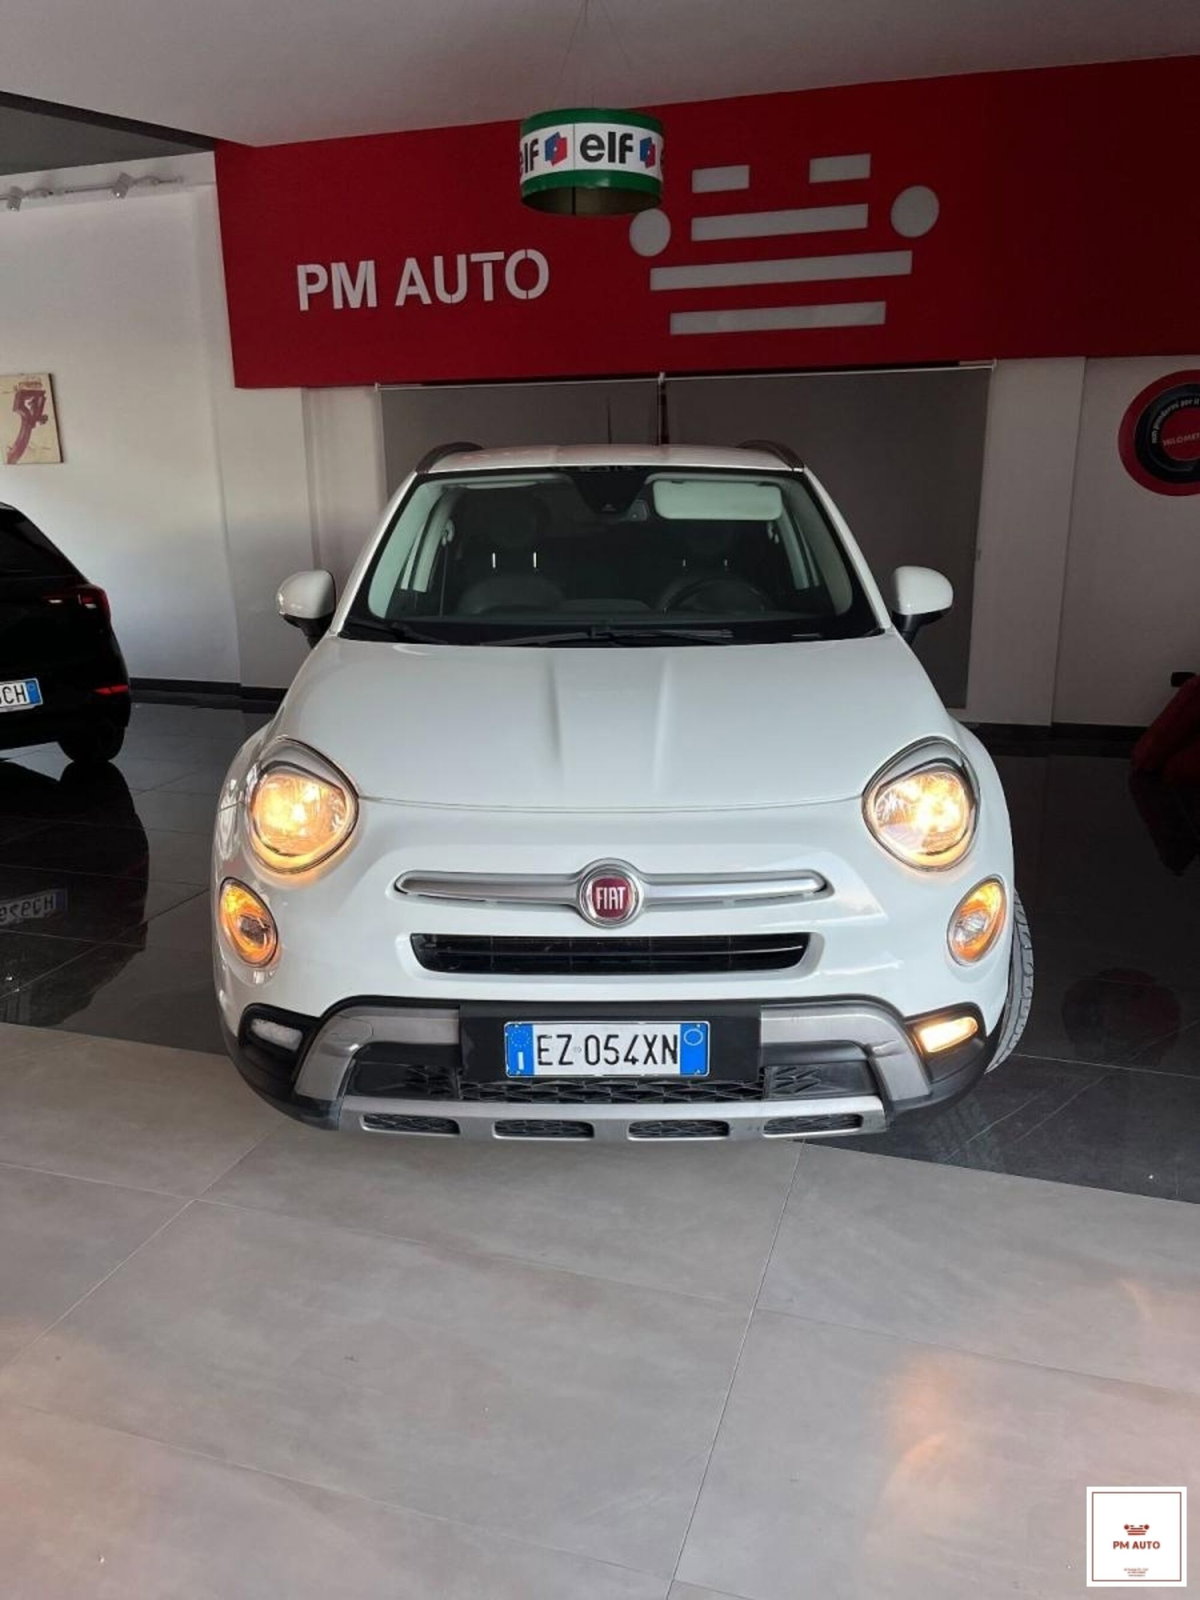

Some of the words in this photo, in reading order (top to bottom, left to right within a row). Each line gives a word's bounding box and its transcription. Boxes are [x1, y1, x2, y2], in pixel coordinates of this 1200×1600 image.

[520, 138, 539, 174] lf
[580, 131, 634, 164] elf
[296, 259, 378, 312] PM
[394, 248, 550, 307] AUTO
[0, 684, 27, 704] CH
[595, 886, 626, 910] FIAT
[537, 1034, 573, 1066] EZ
[584, 1034, 678, 1066] 054XN
